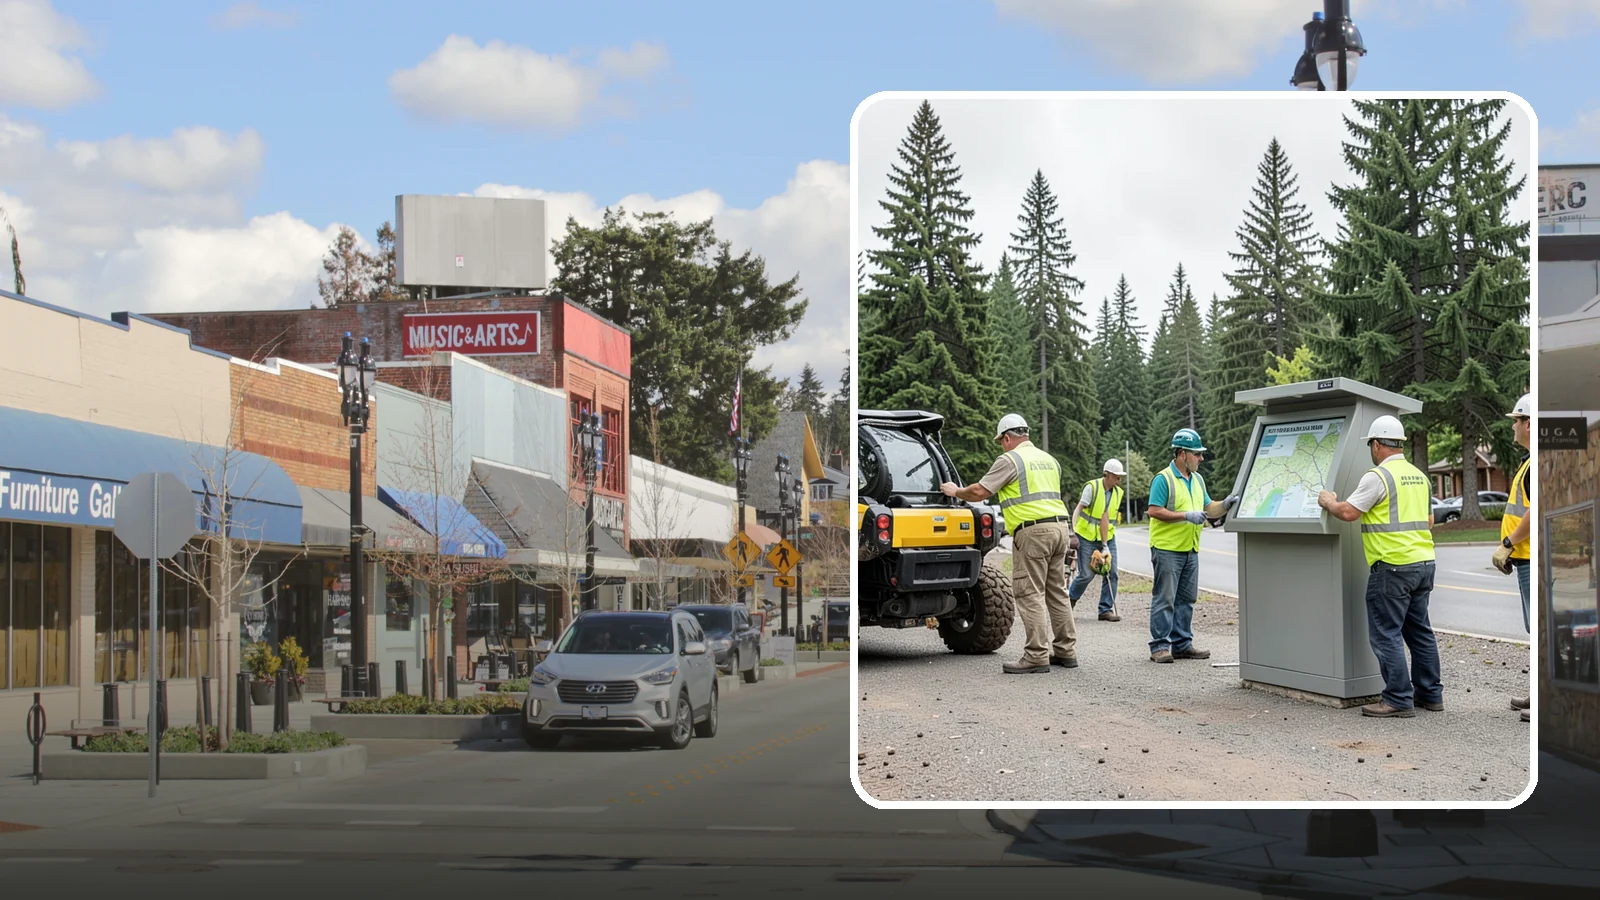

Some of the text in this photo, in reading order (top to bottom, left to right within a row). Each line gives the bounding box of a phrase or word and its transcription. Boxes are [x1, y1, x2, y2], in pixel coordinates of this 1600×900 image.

[1540, 427, 1577, 437] UGA
[0, 471, 121, 519] Furniture Gal
